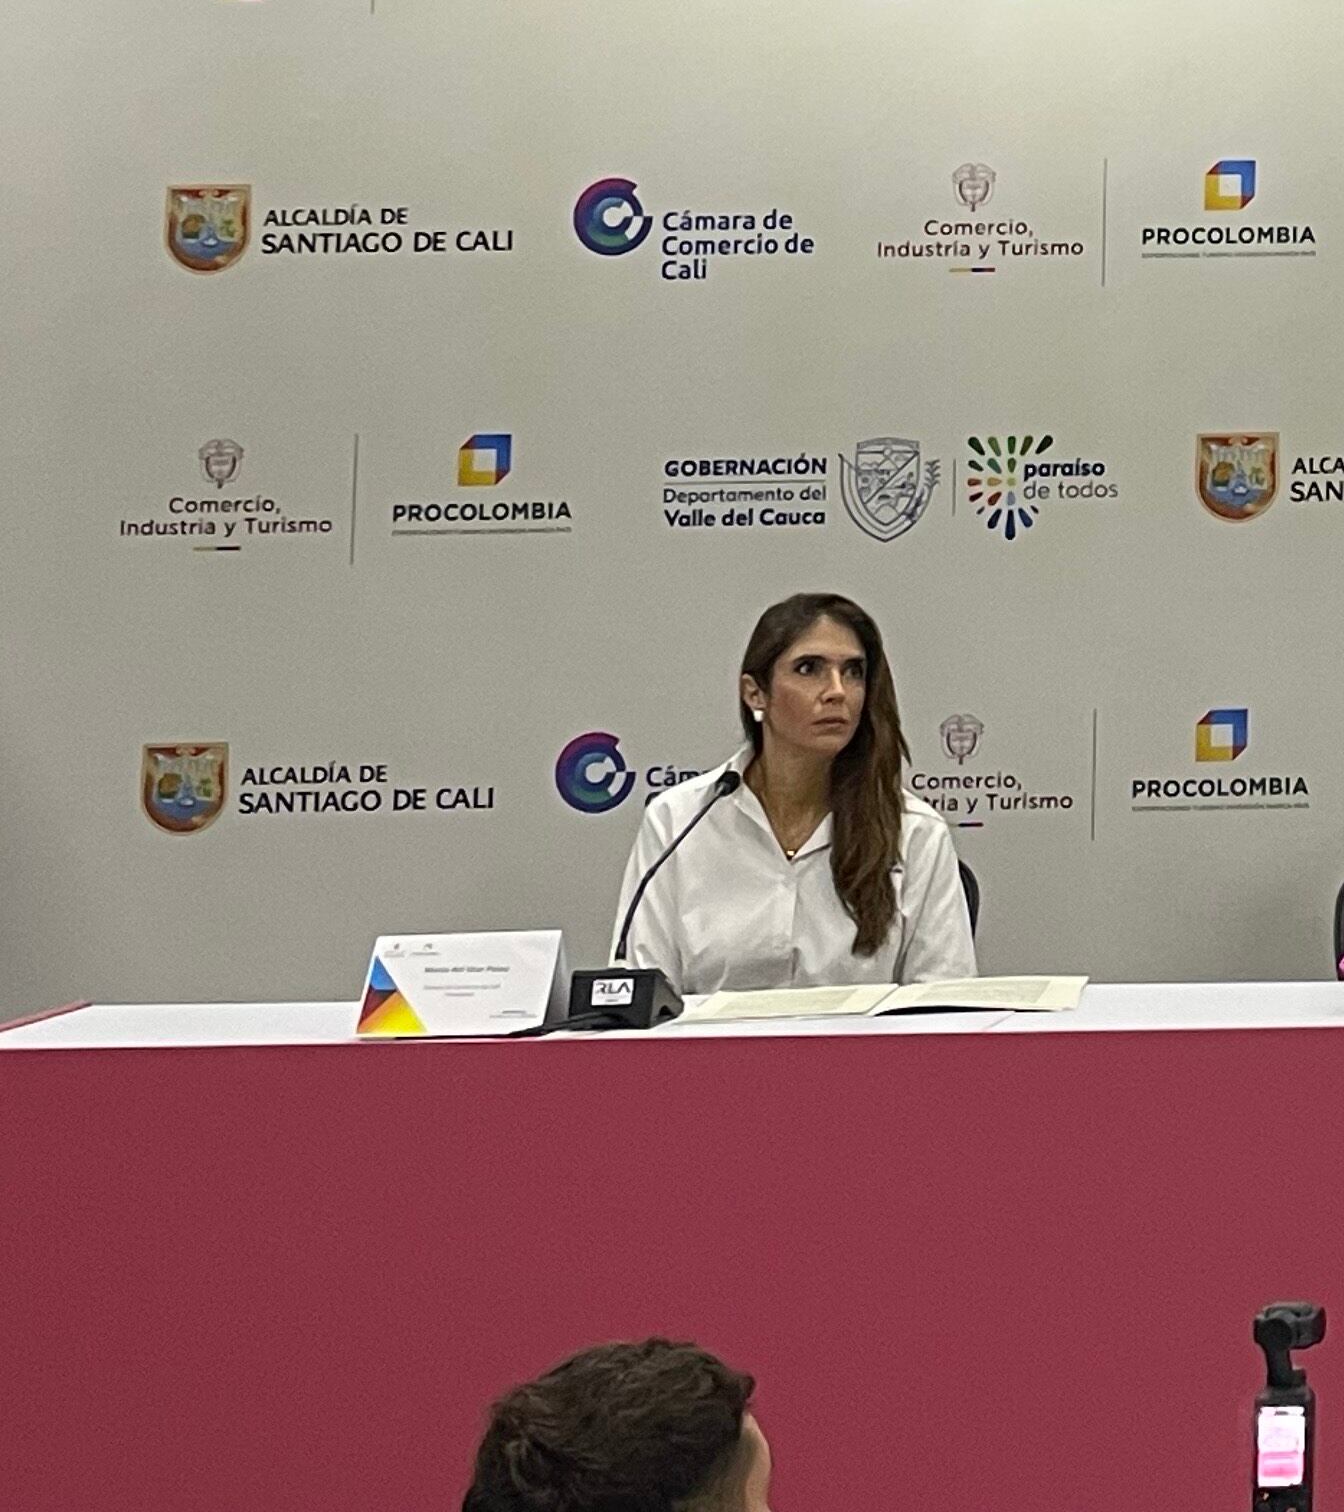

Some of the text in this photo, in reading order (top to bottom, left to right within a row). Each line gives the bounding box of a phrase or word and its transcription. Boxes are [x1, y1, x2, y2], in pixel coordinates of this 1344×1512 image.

[263, 204, 408, 227] ALCALDÍA DE
[662, 208, 793, 232] Cámara de
[923, 219, 1034, 238] Comercio,
[1141, 226, 1316, 245] PROCOLOMBIA
[261, 229, 513, 255] SANTIAGO DE CALI
[662, 235, 815, 256] Comercio de
[877, 239, 1084, 260] Industria y Turismo
[661, 259, 707, 281] Cali
[664, 452, 827, 477] GOBERNACIÓN
[1023, 457, 1106, 482] paraíso
[168, 495, 281, 515] Comercio,
[392, 501, 572, 523] PROCOLOMBIA
[120, 516, 333, 539] Industria y Turismo
[663, 507, 826, 527] Valle del Cauca
[240, 760, 388, 786] ALCALDÍA DE
[911, 771, 1022, 791] Comercio,
[1132, 776, 1309, 799] PROCOLOMBIA
[238, 786, 494, 815] SANTIAGO DE CALI
